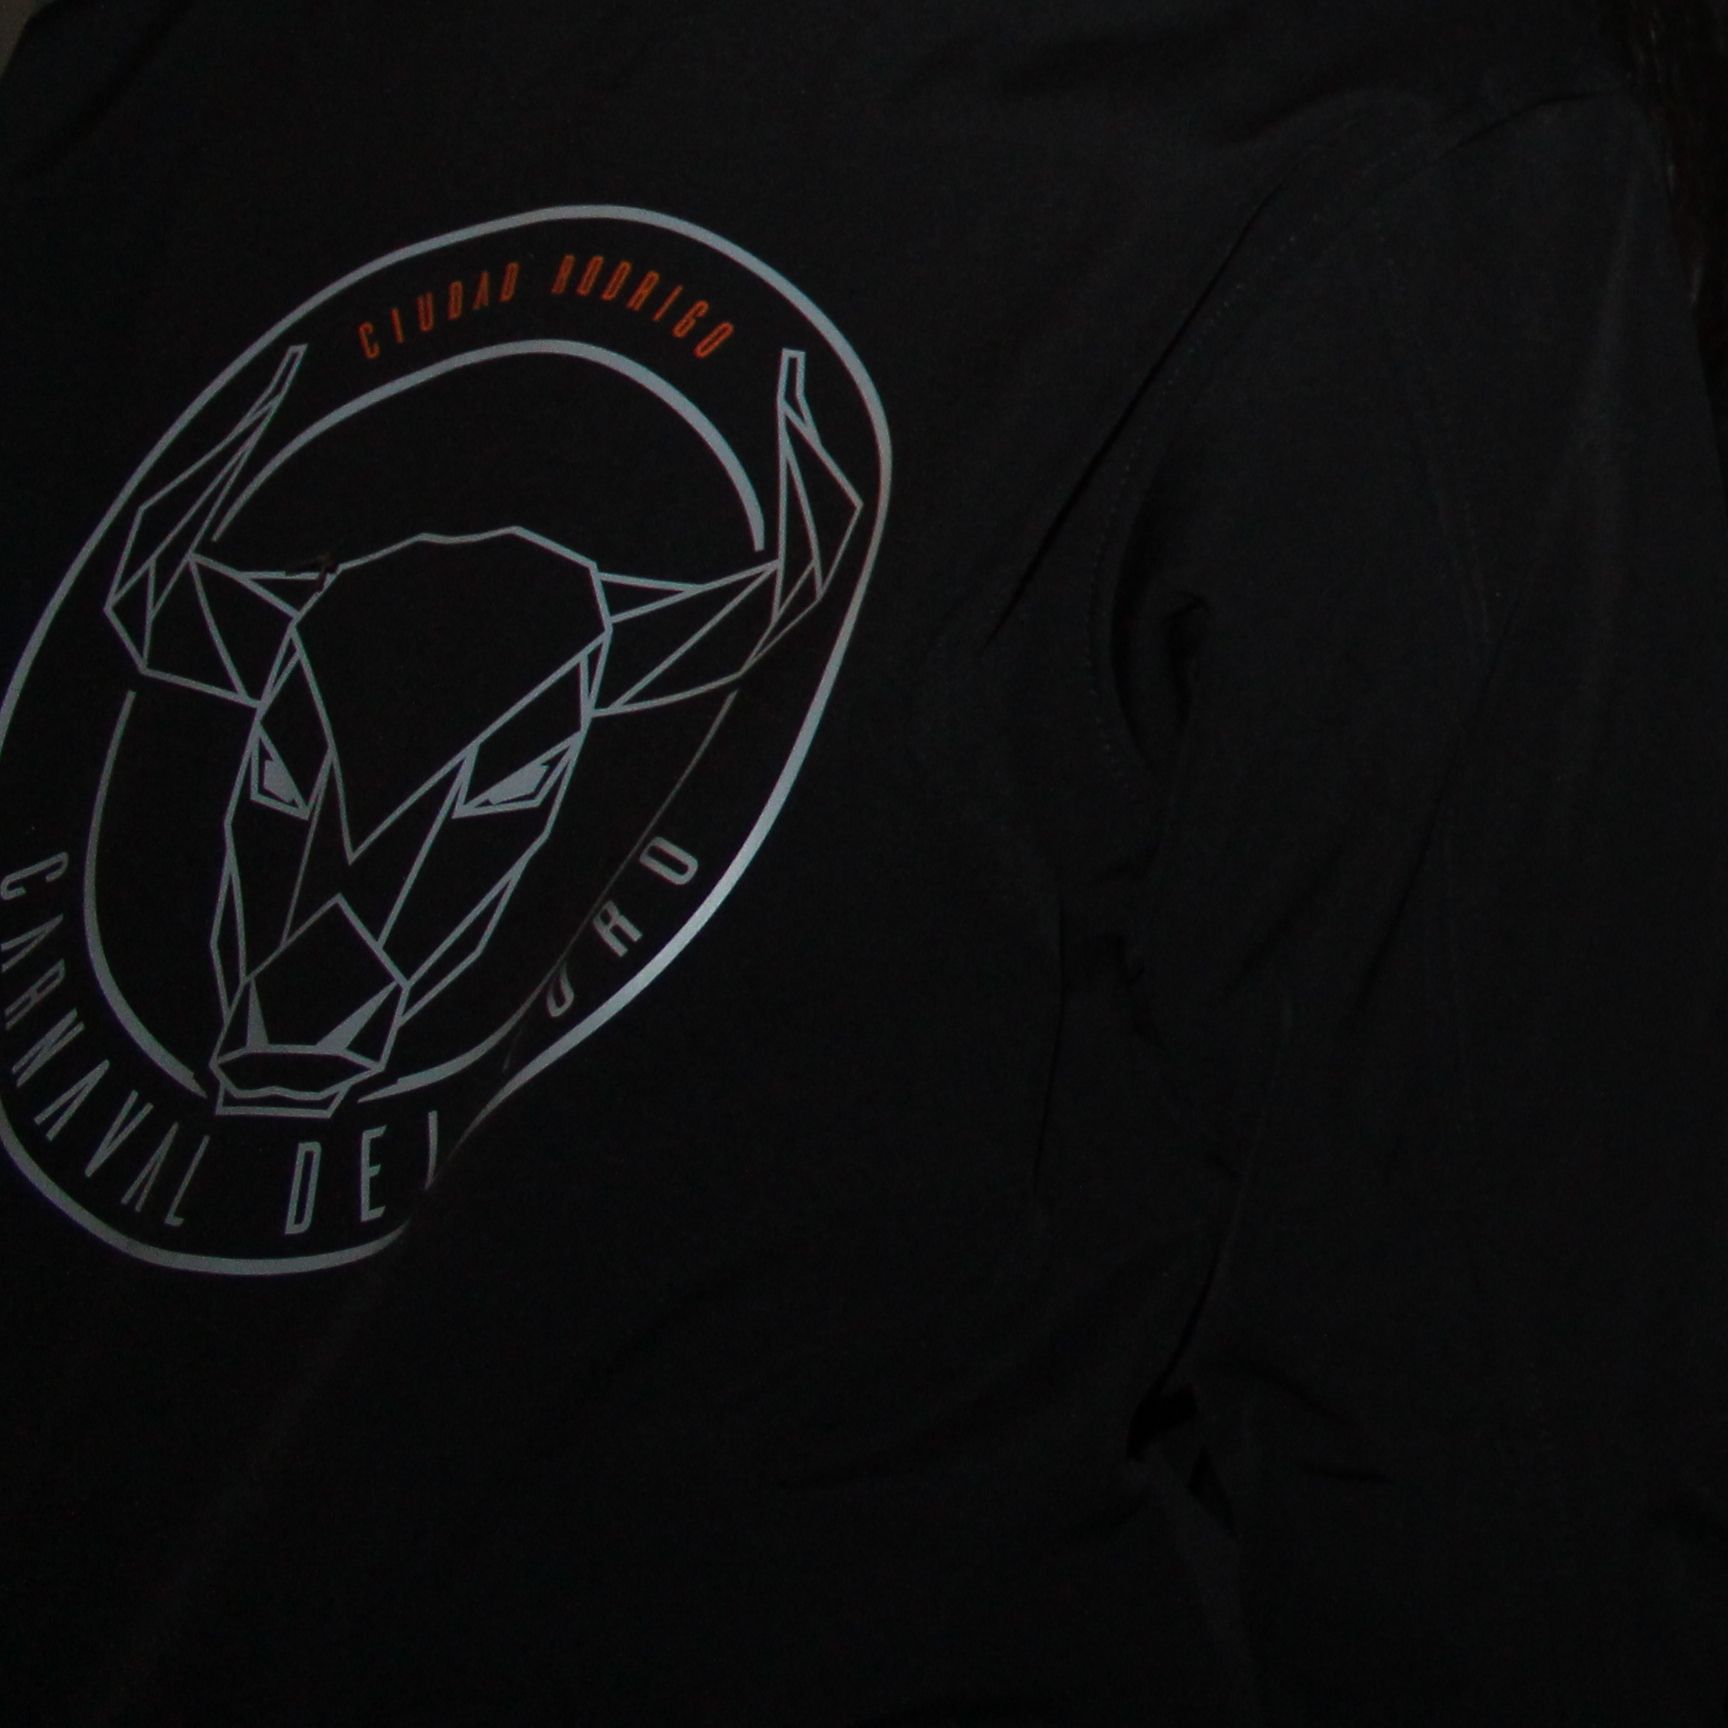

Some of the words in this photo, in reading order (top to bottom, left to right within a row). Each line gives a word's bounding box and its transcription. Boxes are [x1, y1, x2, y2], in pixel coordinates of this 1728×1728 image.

[357, 260, 521, 360] CIUDAD
[550, 252, 735, 360] RODRIGO
[0, 851, 211, 1226] CARNAVAL
[520, 836, 699, 1042] ORO
